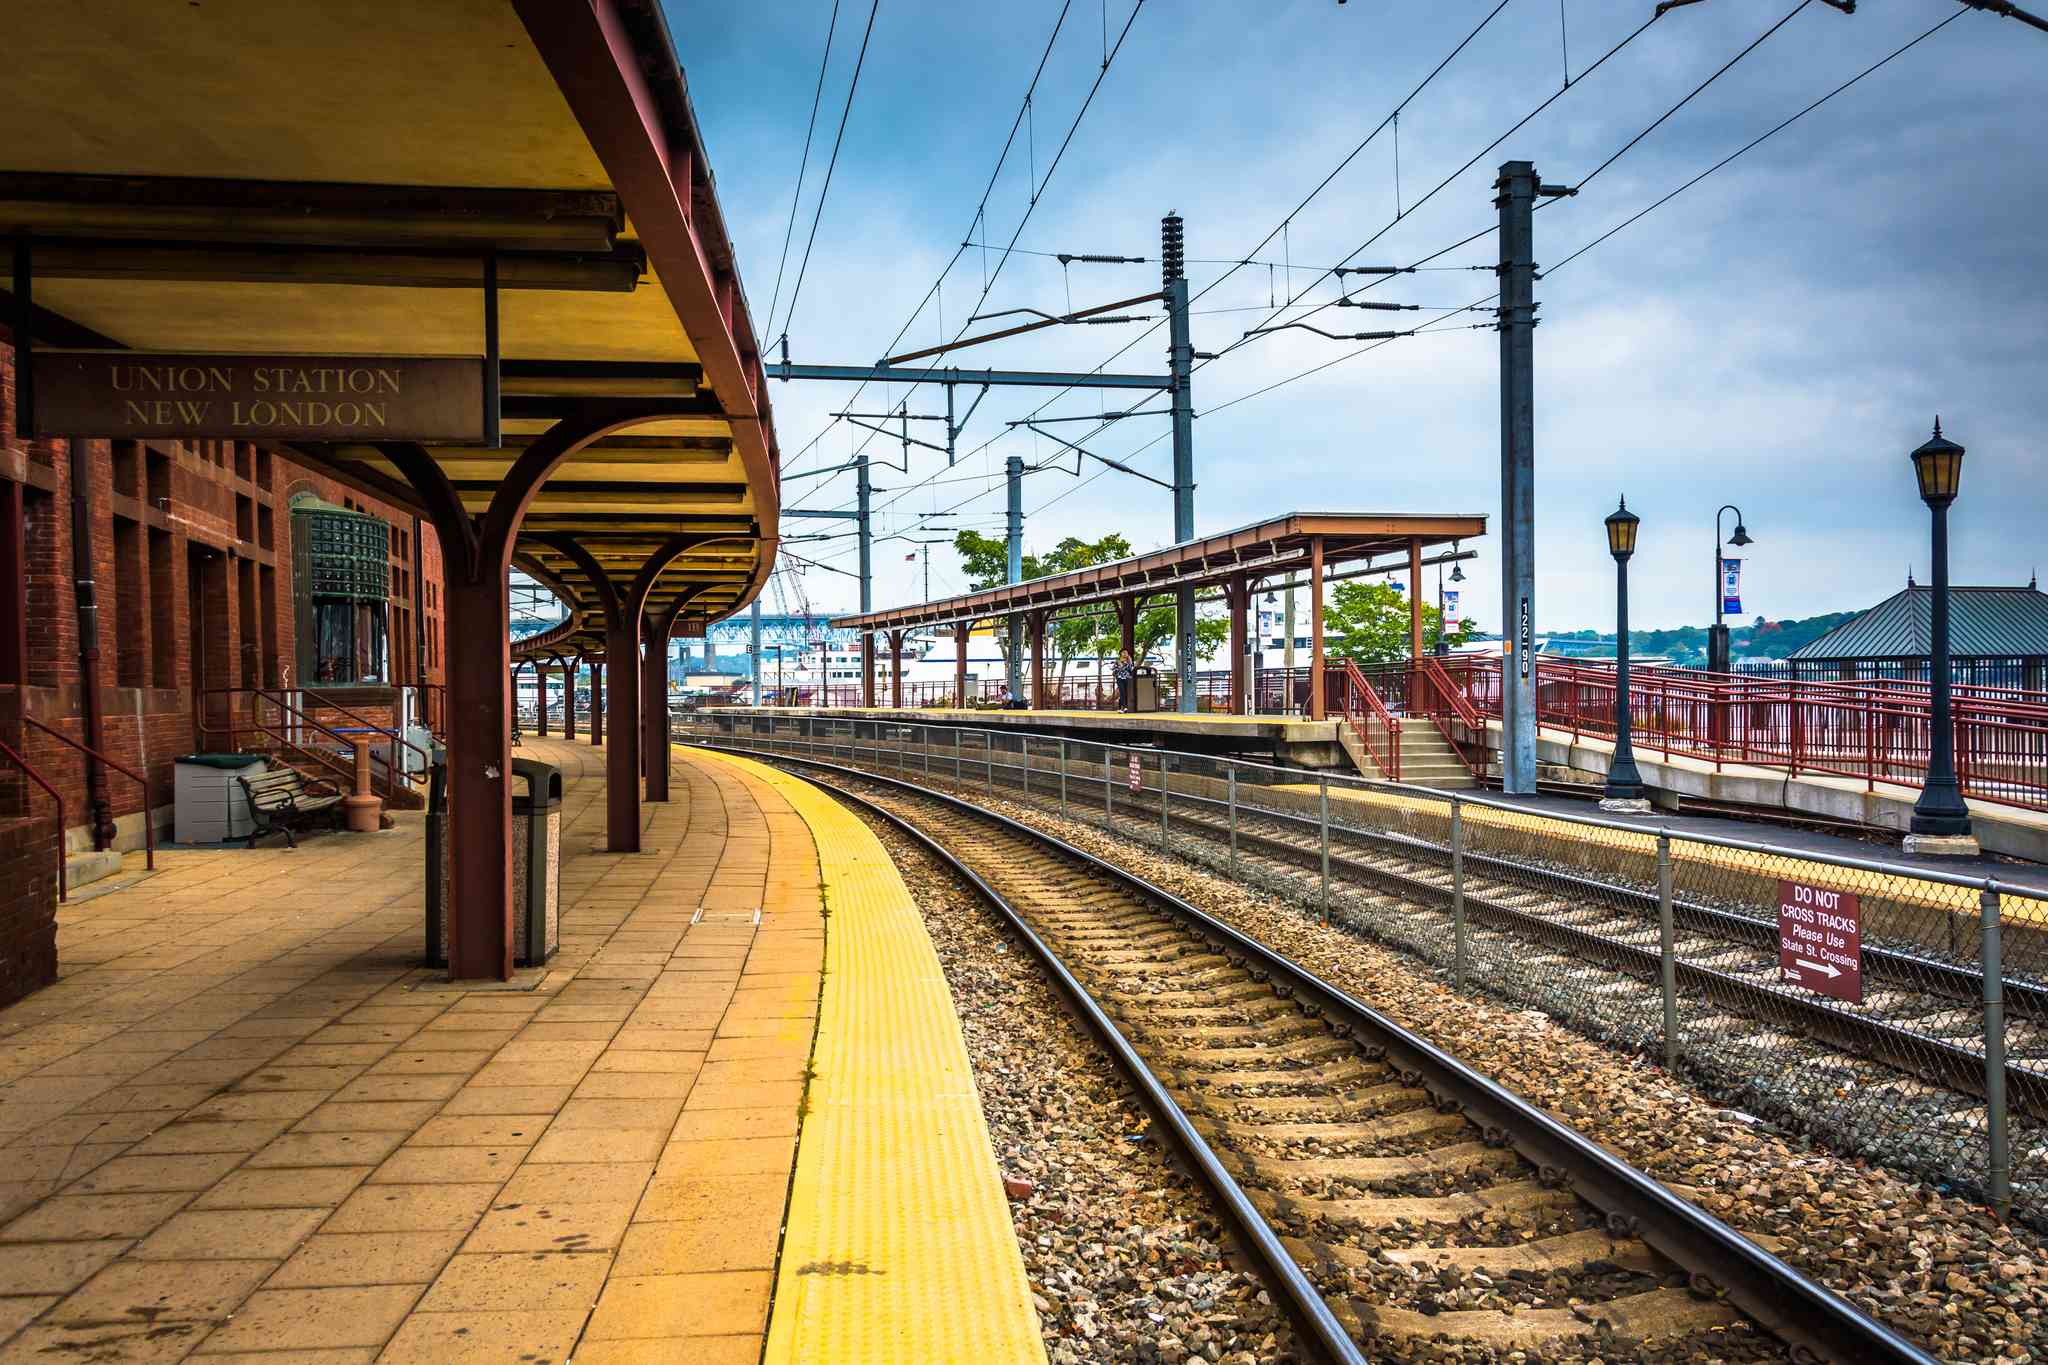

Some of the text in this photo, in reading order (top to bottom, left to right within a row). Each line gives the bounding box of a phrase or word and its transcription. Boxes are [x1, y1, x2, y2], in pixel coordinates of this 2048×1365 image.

[111, 366, 401, 393] UNION STATION
[125, 399, 386, 426] NEW LONDON
[1794, 885, 1840, 910] DO NOT
[1781, 903, 1857, 934] CROSS TRACKS
[1792, 923, 1846, 949] Please Use
[1782, 937, 1858, 972] State St. Crossing
